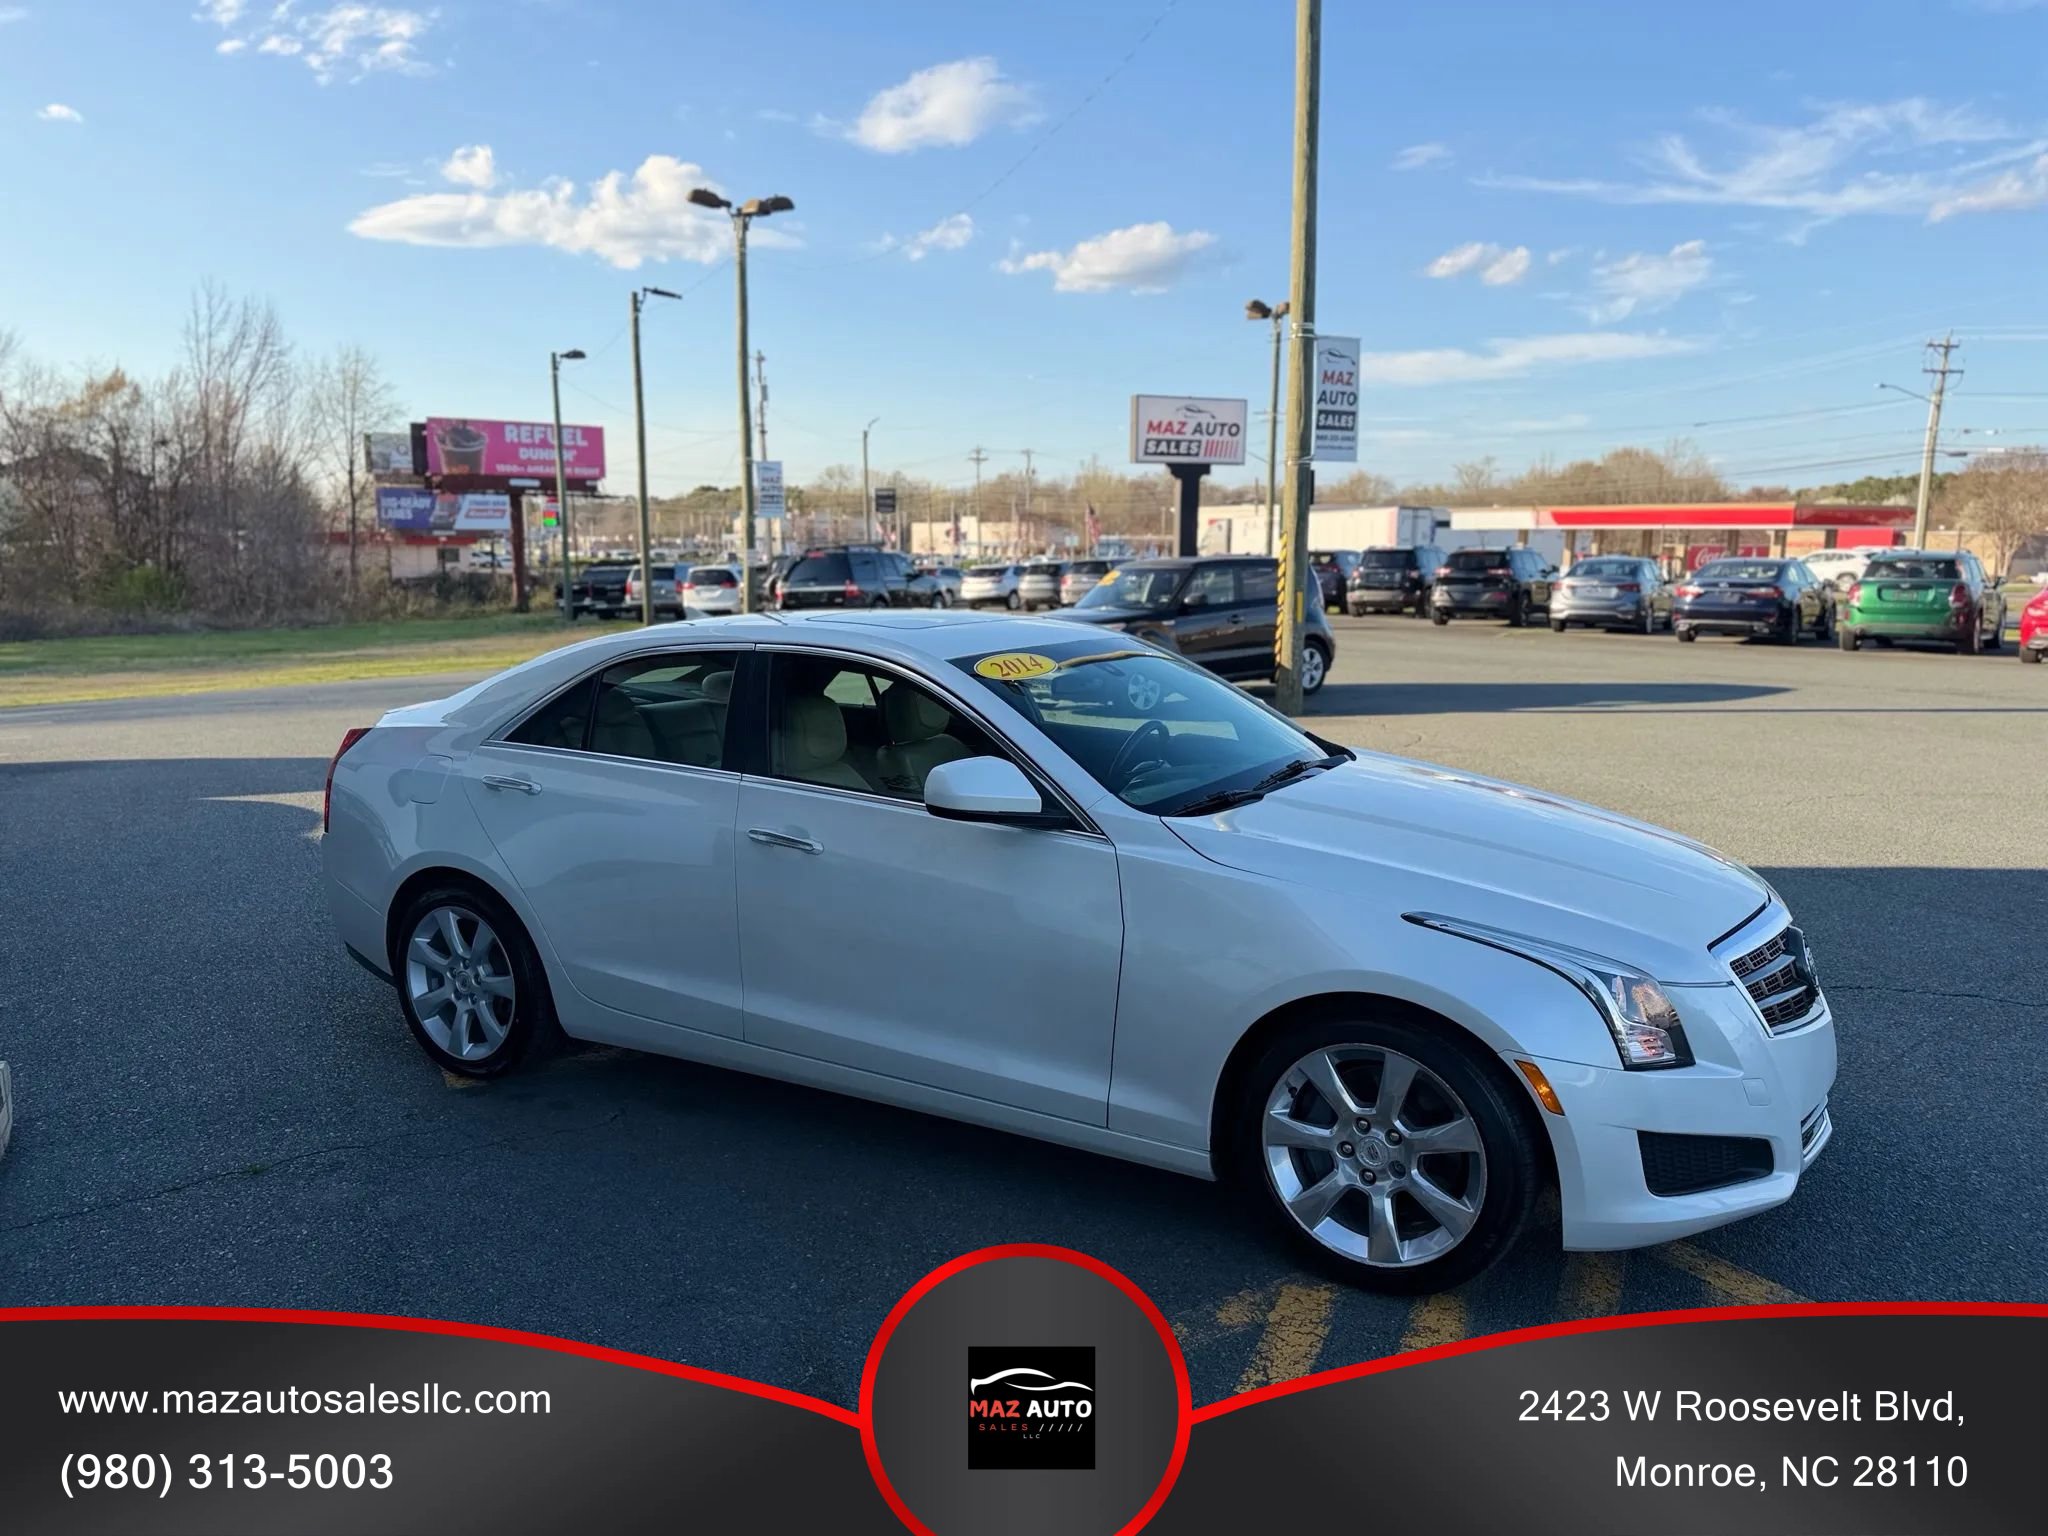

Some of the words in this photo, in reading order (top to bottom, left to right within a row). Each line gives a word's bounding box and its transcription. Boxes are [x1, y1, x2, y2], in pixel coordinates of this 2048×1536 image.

[1322, 370, 1354, 386] MAZ
[1317, 390, 1357, 407] AUTO
[1146, 420, 1188, 435] MAZ
[1191, 422, 1240, 437] AUTO
[1318, 414, 1353, 428] SALES
[518, 448, 576, 462] DUNKN'
[1146, 440, 1199, 455] SALES
[990, 655, 1044, 677] 2014
